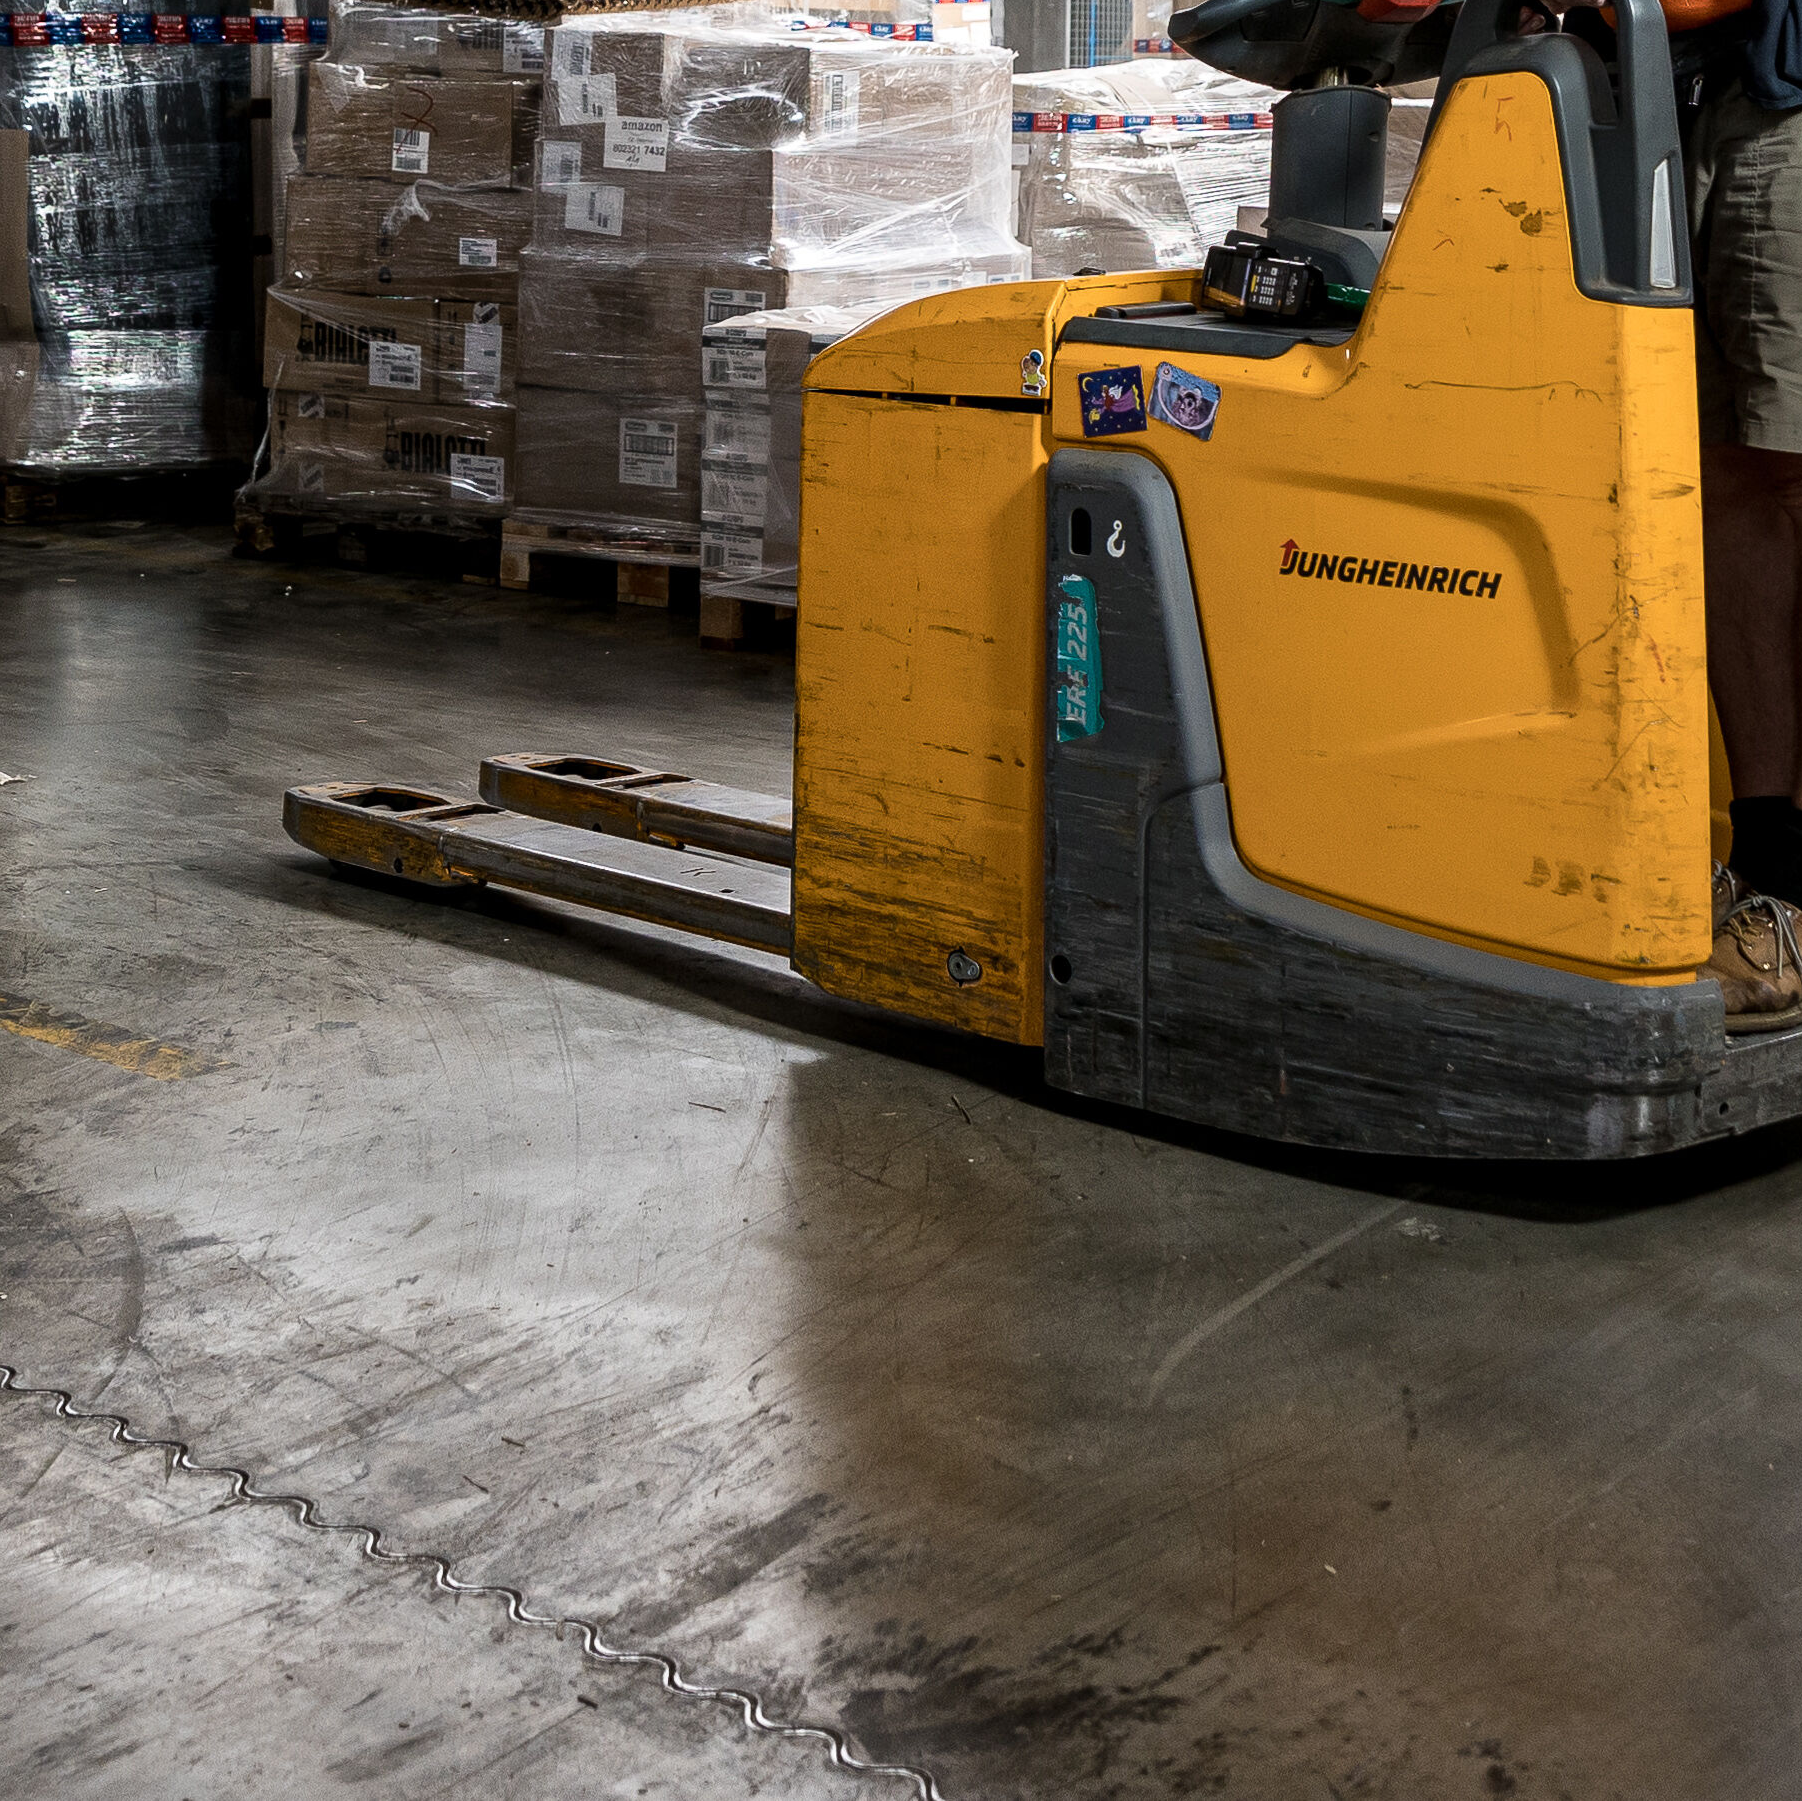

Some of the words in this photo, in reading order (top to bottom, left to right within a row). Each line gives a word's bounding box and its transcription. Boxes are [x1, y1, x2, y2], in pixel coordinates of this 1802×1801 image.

[621, 119, 663, 133] amazon
[642, 145, 666, 157] 7432
[1279, 548, 1503, 600] JUNGHEINRICH
[1066, 602, 1088, 661] 225
